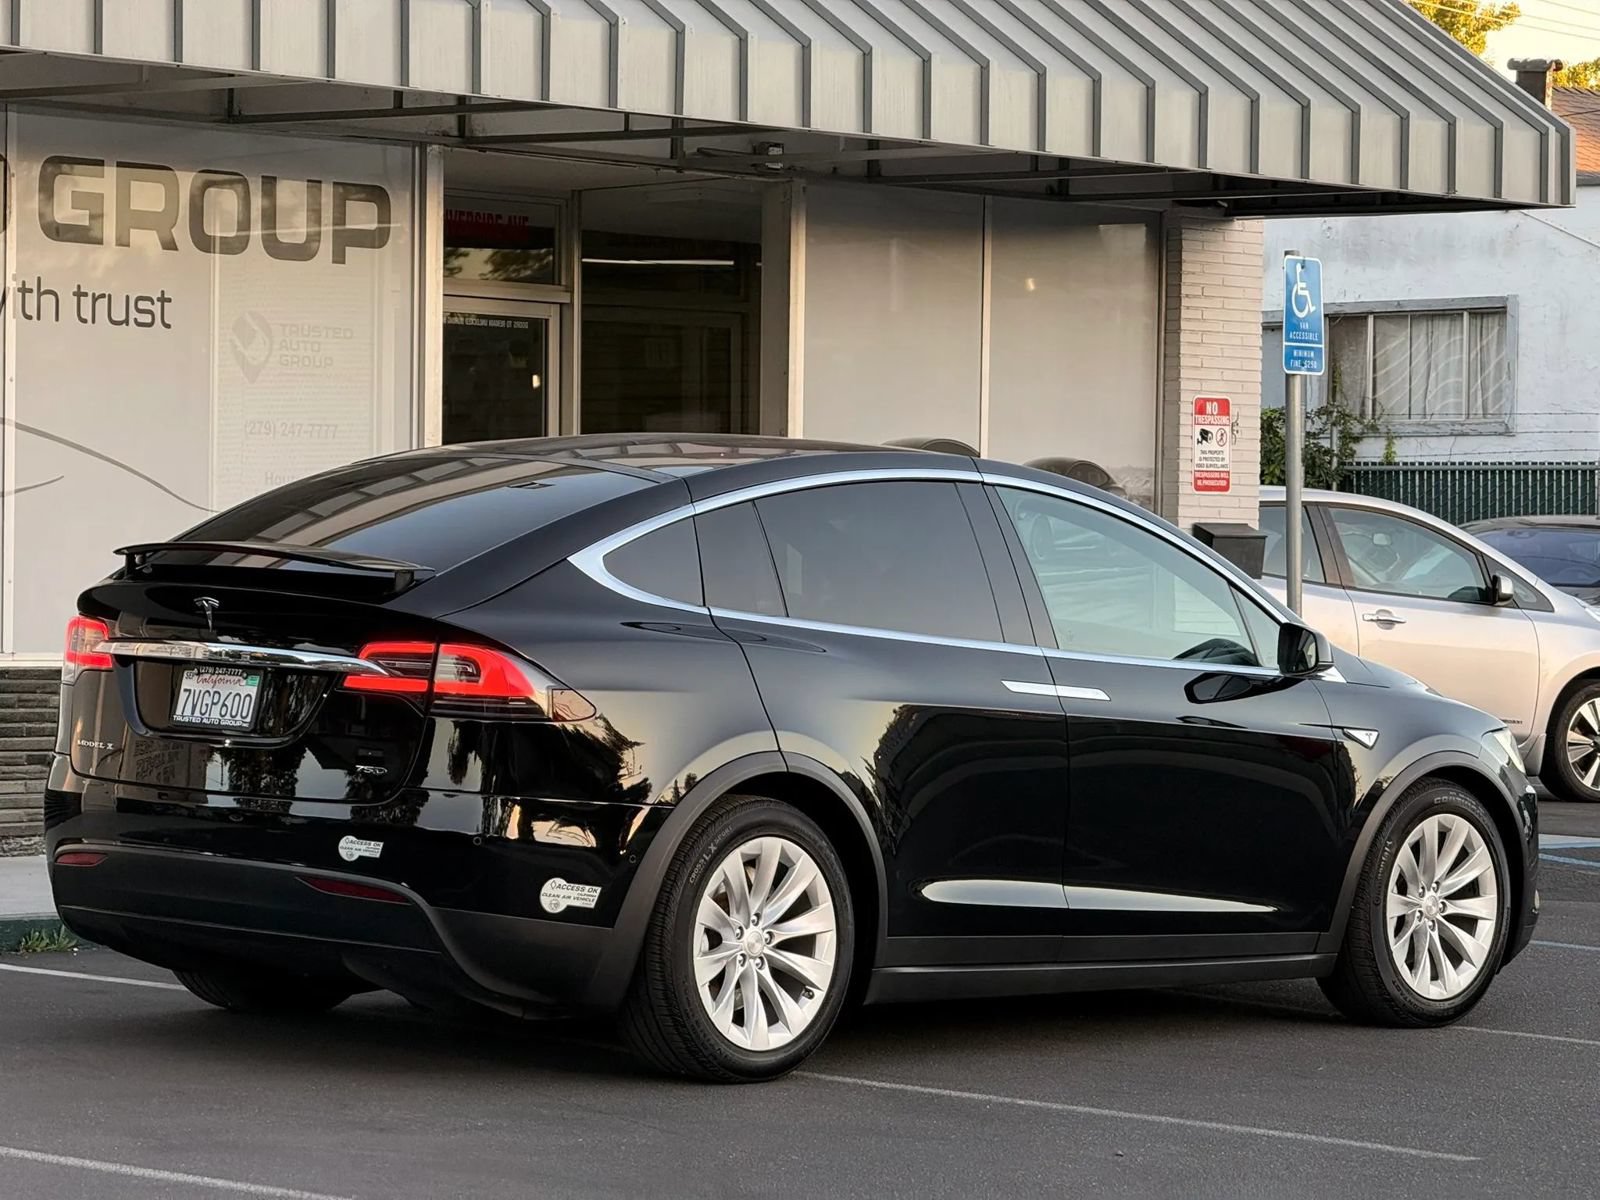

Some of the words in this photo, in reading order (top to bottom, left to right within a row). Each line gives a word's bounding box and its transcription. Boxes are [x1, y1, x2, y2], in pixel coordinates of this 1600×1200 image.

[38, 155, 391, 264] GROUP
[72, 284, 172, 329] trust
[279, 323, 353, 340] TRUSTED
[1289, 331, 1319, 341] ACCESSIBLE
[279, 339, 321, 353] AUTO
[279, 354, 333, 368] GROUP
[1293, 350, 1315, 358] MINIMUM
[1206, 401, 1218, 415] NO
[1195, 415, 1230, 425] TRESPASSING
[244, 420, 276, 440] (279)
[199, 667, 215, 675] (279)
[215, 667, 242, 676] 247-7777
[196, 673, 243, 688] California
[181, 688, 253, 719] 7VGP600
[173, 715, 201, 723] TRUSTED
[202, 717, 219, 725] AUTO
[220, 719, 242, 727] GROUP
[77, 739, 105, 749] MODEL
[106, 742, 114, 750] X
[541, 891, 561, 899] CLEAN
[556, 883, 586, 893] ACCESS
